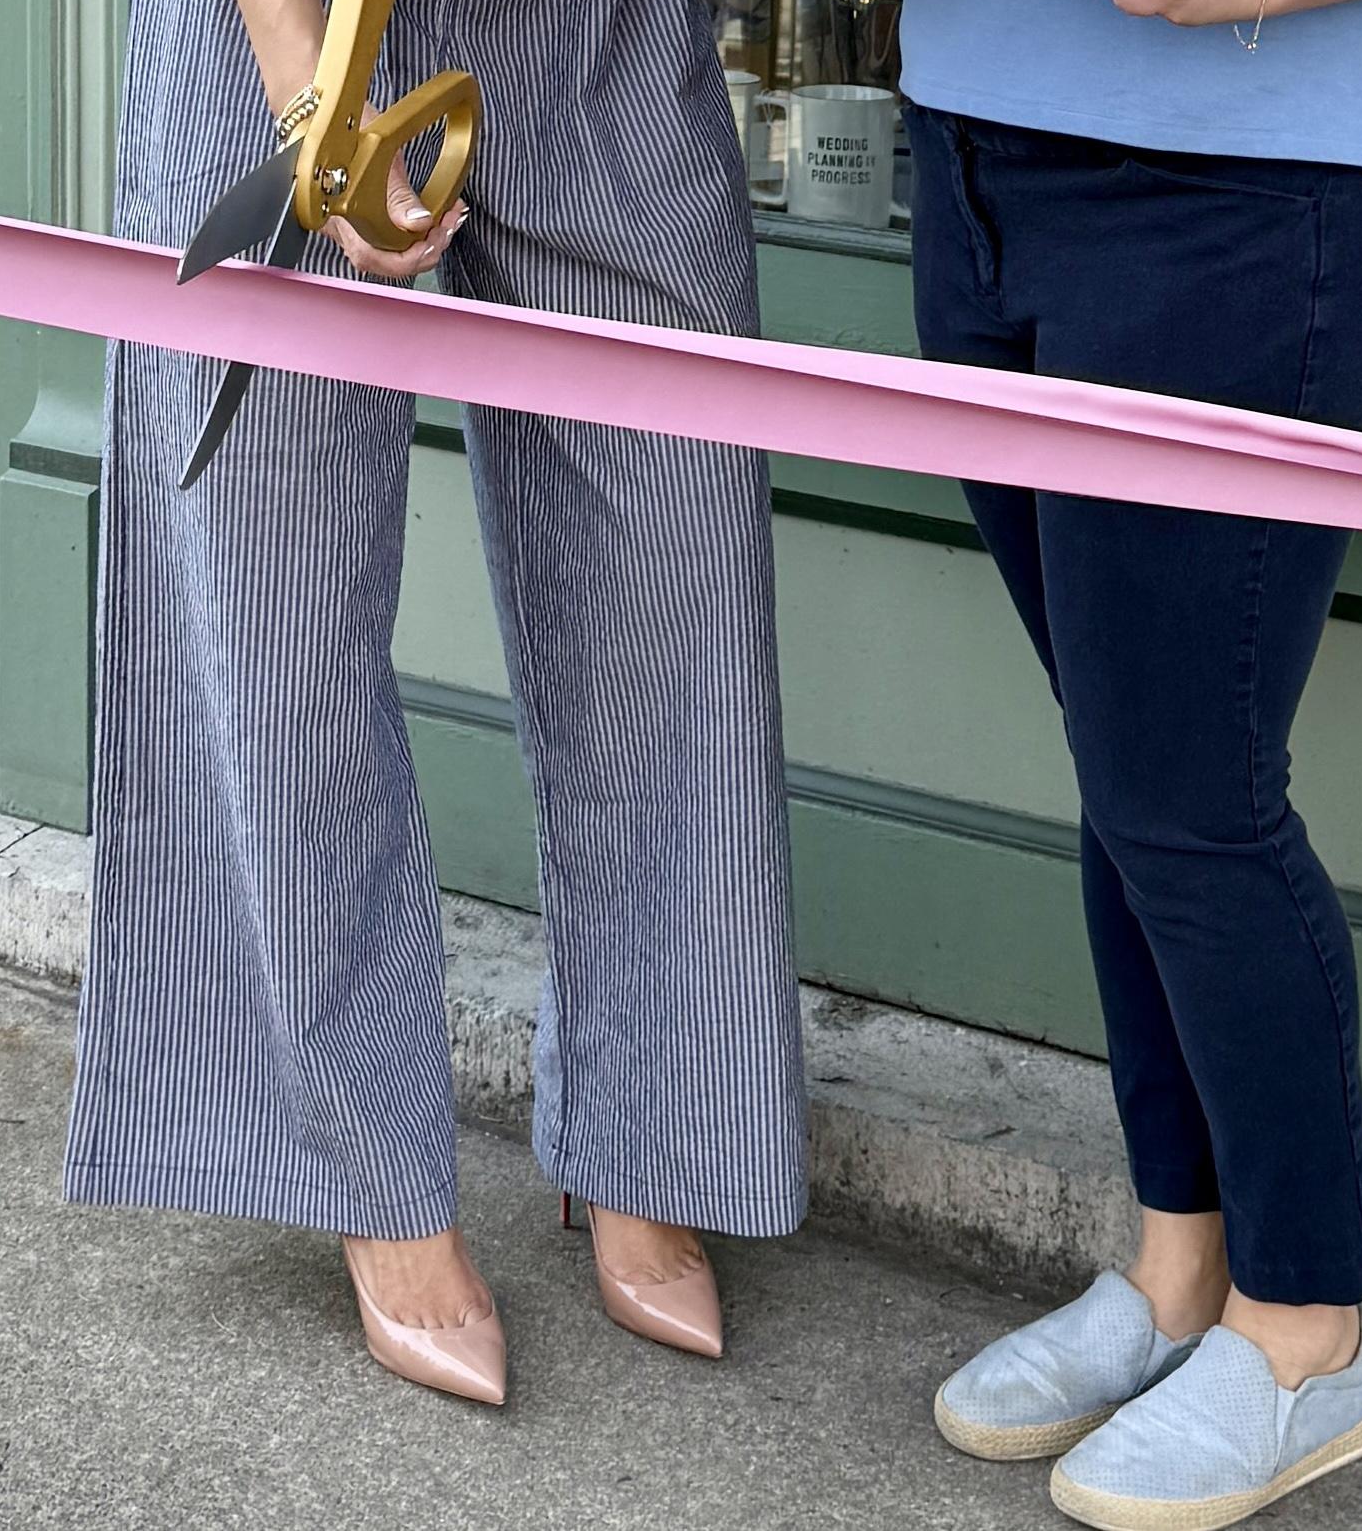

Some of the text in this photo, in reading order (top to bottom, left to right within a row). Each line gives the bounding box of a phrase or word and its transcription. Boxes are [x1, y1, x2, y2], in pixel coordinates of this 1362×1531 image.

[817, 136, 868, 151] WEDDING
[808, 152, 863, 168] PLANNING
[811, 169, 871, 185] PROGRESS
